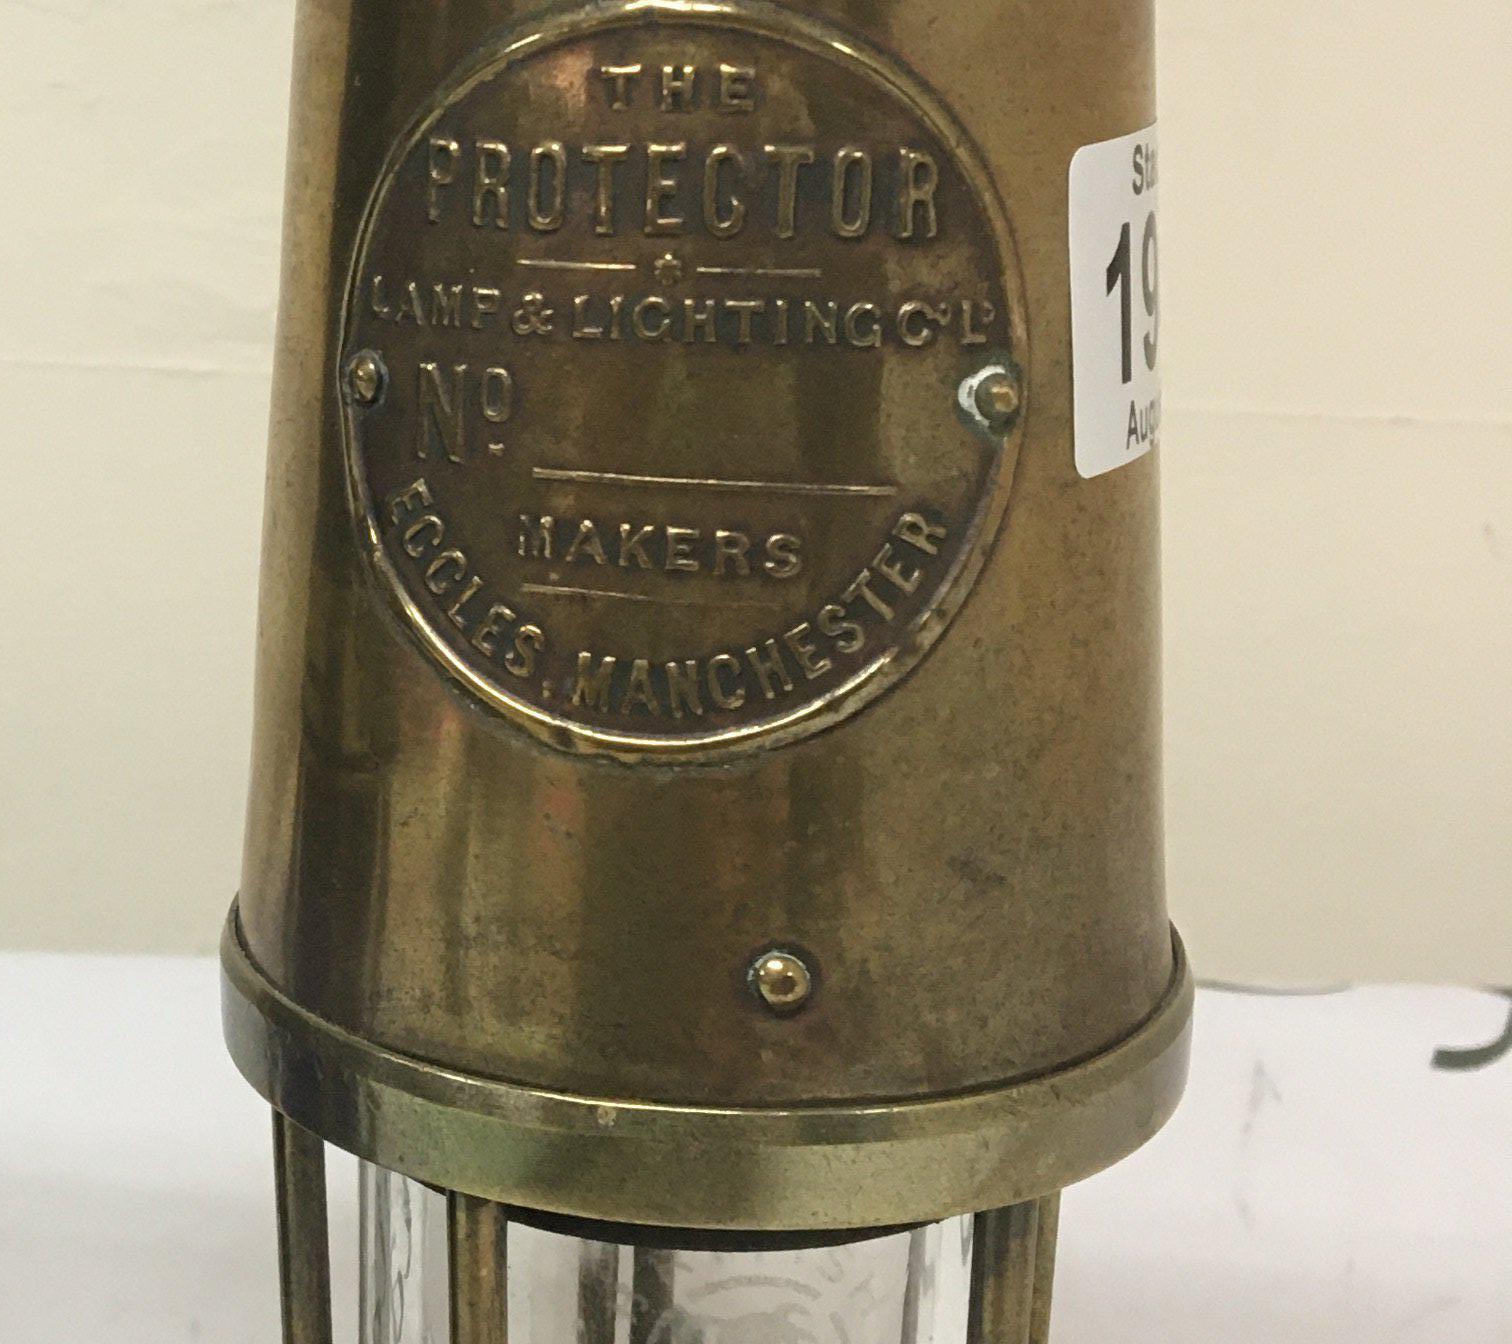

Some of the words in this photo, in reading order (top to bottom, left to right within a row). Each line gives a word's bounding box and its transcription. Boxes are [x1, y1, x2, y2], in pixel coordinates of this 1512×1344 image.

[599, 63, 756, 112] THE
[428, 137, 939, 239] PROTECTOR
[371, 274, 501, 330] LAMP
[512, 291, 555, 337] &
[571, 294, 883, 349] LIGHTING
[517, 514, 802, 579] MAKERS
[571, 511, 948, 720] MANCHESTER
